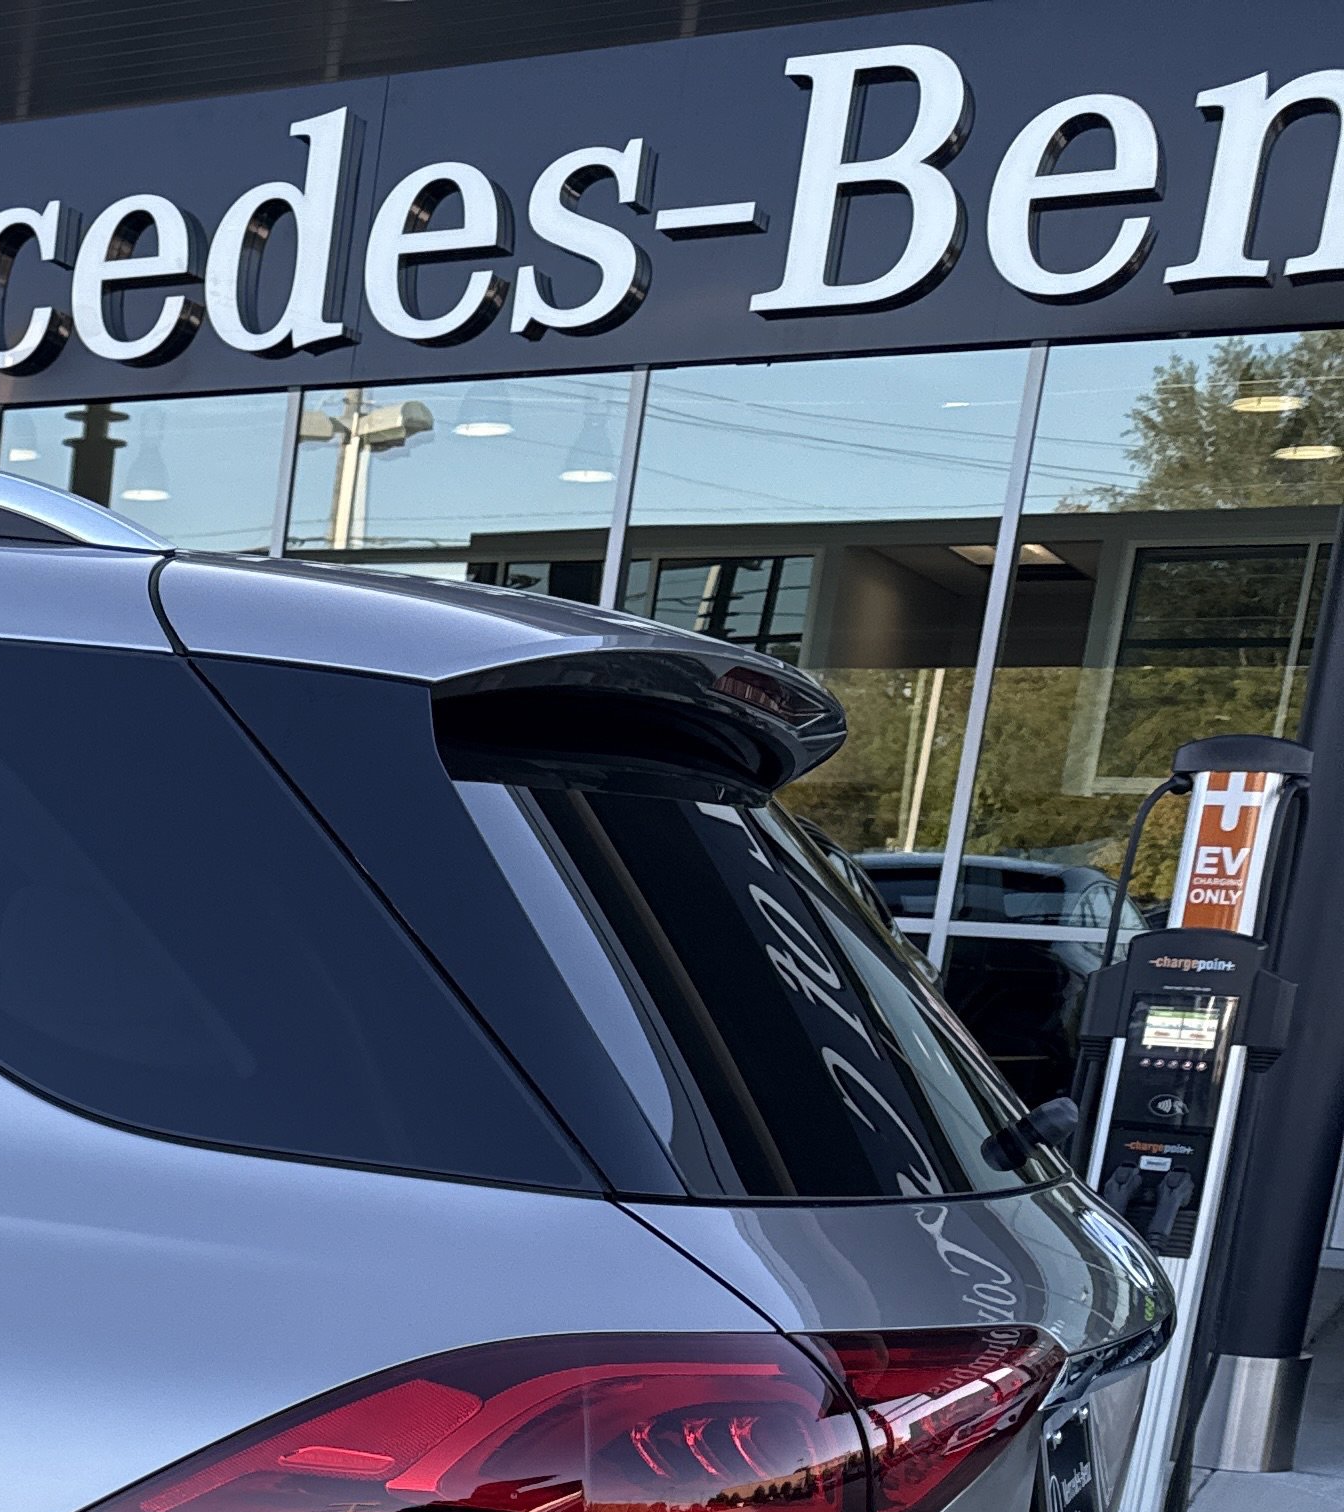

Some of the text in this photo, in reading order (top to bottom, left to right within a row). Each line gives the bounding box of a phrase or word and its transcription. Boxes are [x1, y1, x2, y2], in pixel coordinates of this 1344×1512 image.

[1194, 846, 1251, 876] EV
[1192, 877, 1244, 887] CHARGING
[1190, 888, 1243, 905] ONLY
